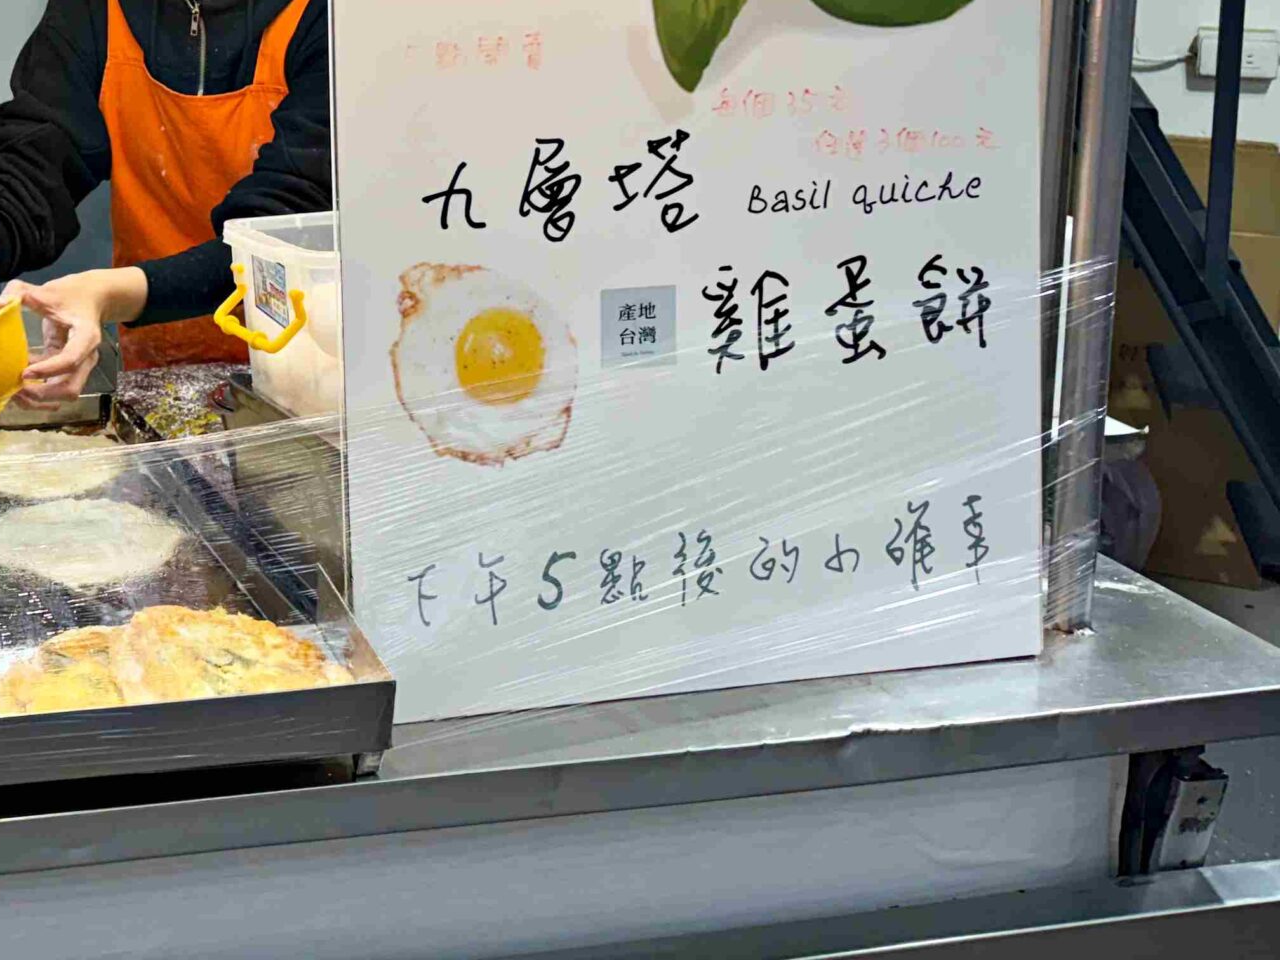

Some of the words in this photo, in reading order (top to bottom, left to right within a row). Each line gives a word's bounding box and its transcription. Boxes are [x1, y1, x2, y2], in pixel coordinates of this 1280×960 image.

[747, 180, 830, 214] Basil
[851, 172, 982, 215] quiche
[618, 302, 656, 321] 產地
[619, 326, 656, 345] 台灣
